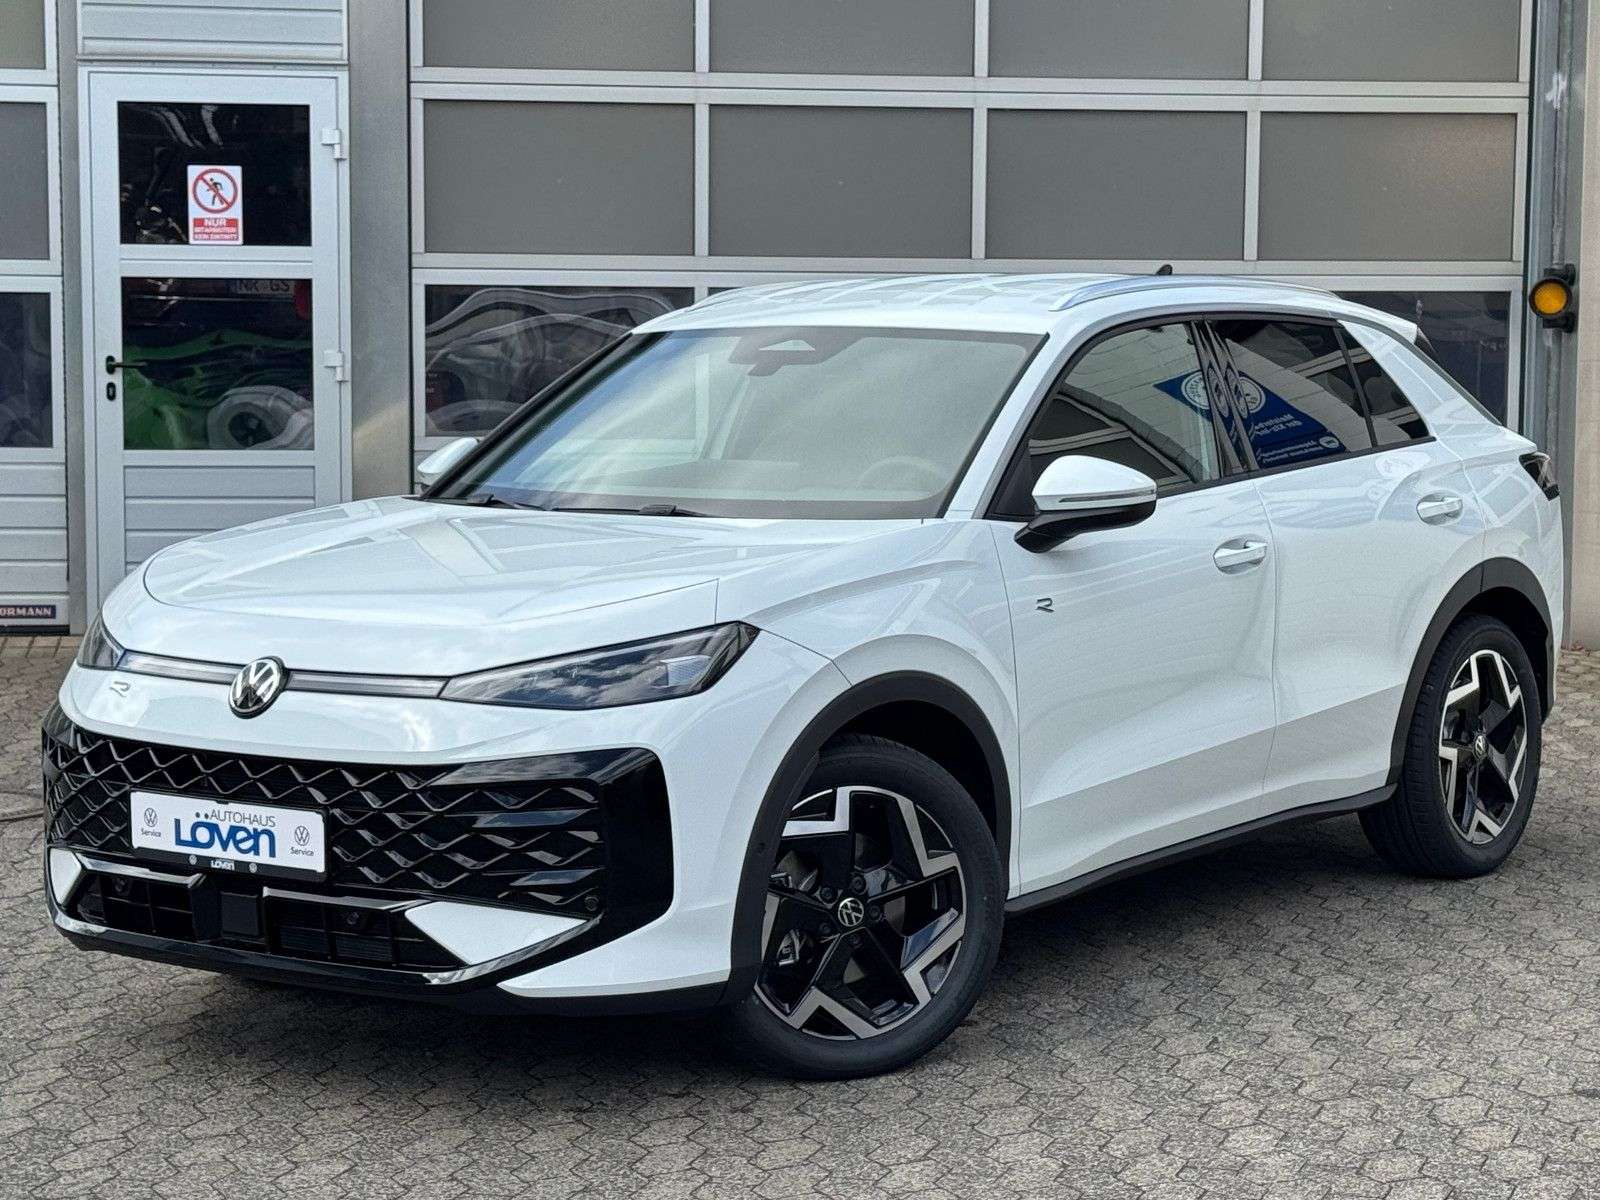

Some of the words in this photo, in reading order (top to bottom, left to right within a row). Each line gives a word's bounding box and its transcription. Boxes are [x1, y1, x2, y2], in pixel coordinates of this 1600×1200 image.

[204, 217, 227, 228] NUR
[210, 809, 276, 828] AUTOHAUS
[140, 828, 162, 839] Service
[174, 812, 276, 858] Löven
[289, 845, 315, 857] Service
